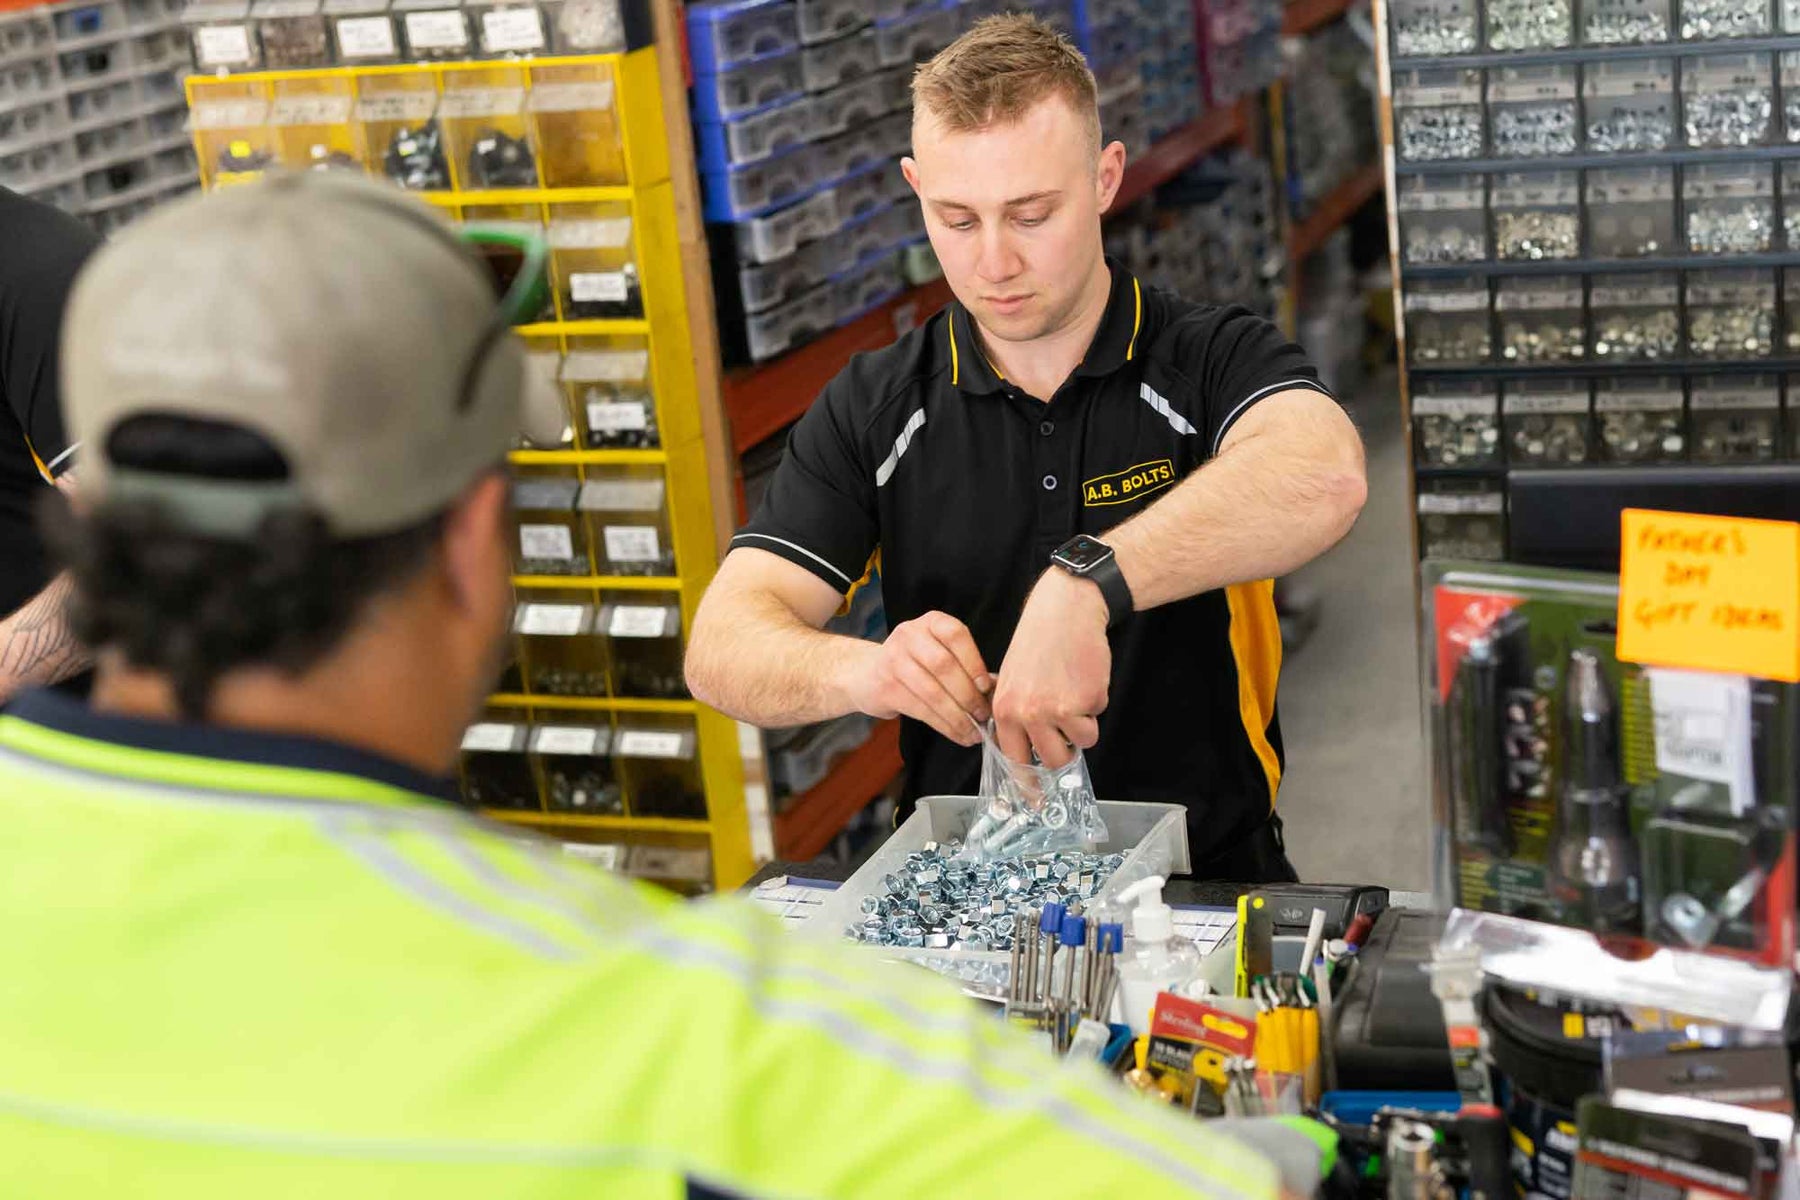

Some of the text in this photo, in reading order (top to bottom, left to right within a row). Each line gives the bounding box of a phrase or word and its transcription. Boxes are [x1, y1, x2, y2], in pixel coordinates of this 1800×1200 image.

[1087, 465, 1170, 501] A.B. BOLTS
[1664, 561, 1711, 586] DAY
